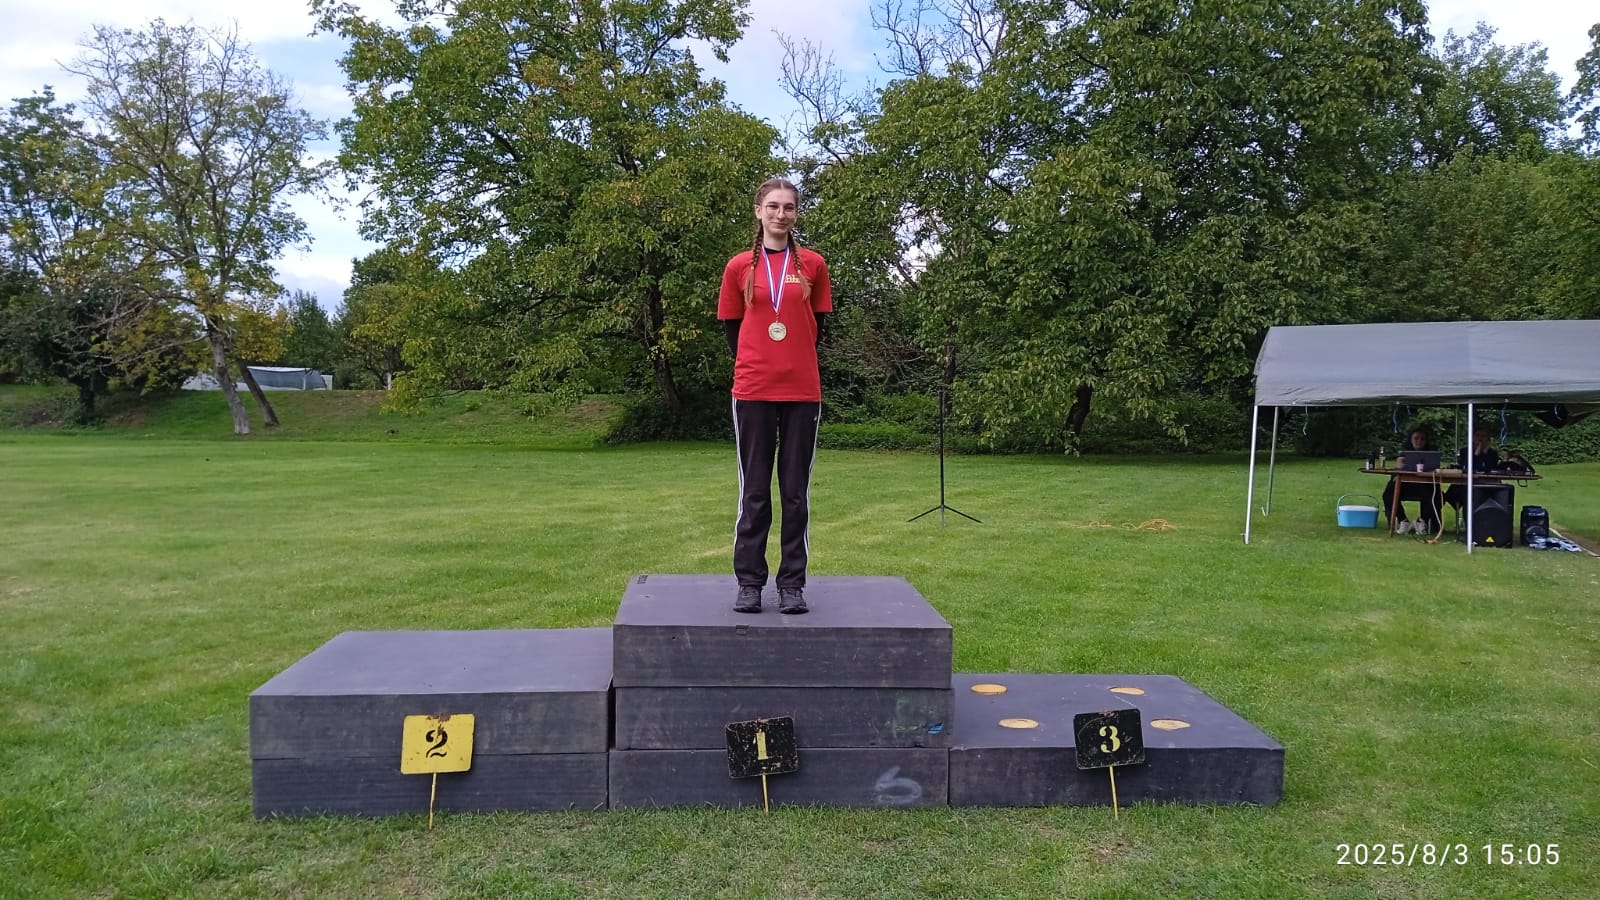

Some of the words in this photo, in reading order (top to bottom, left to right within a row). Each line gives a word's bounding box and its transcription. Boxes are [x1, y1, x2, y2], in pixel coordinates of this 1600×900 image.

[426, 729, 448, 758] 2
[753, 729, 768, 760] 1
[1099, 725, 1120, 753] 3
